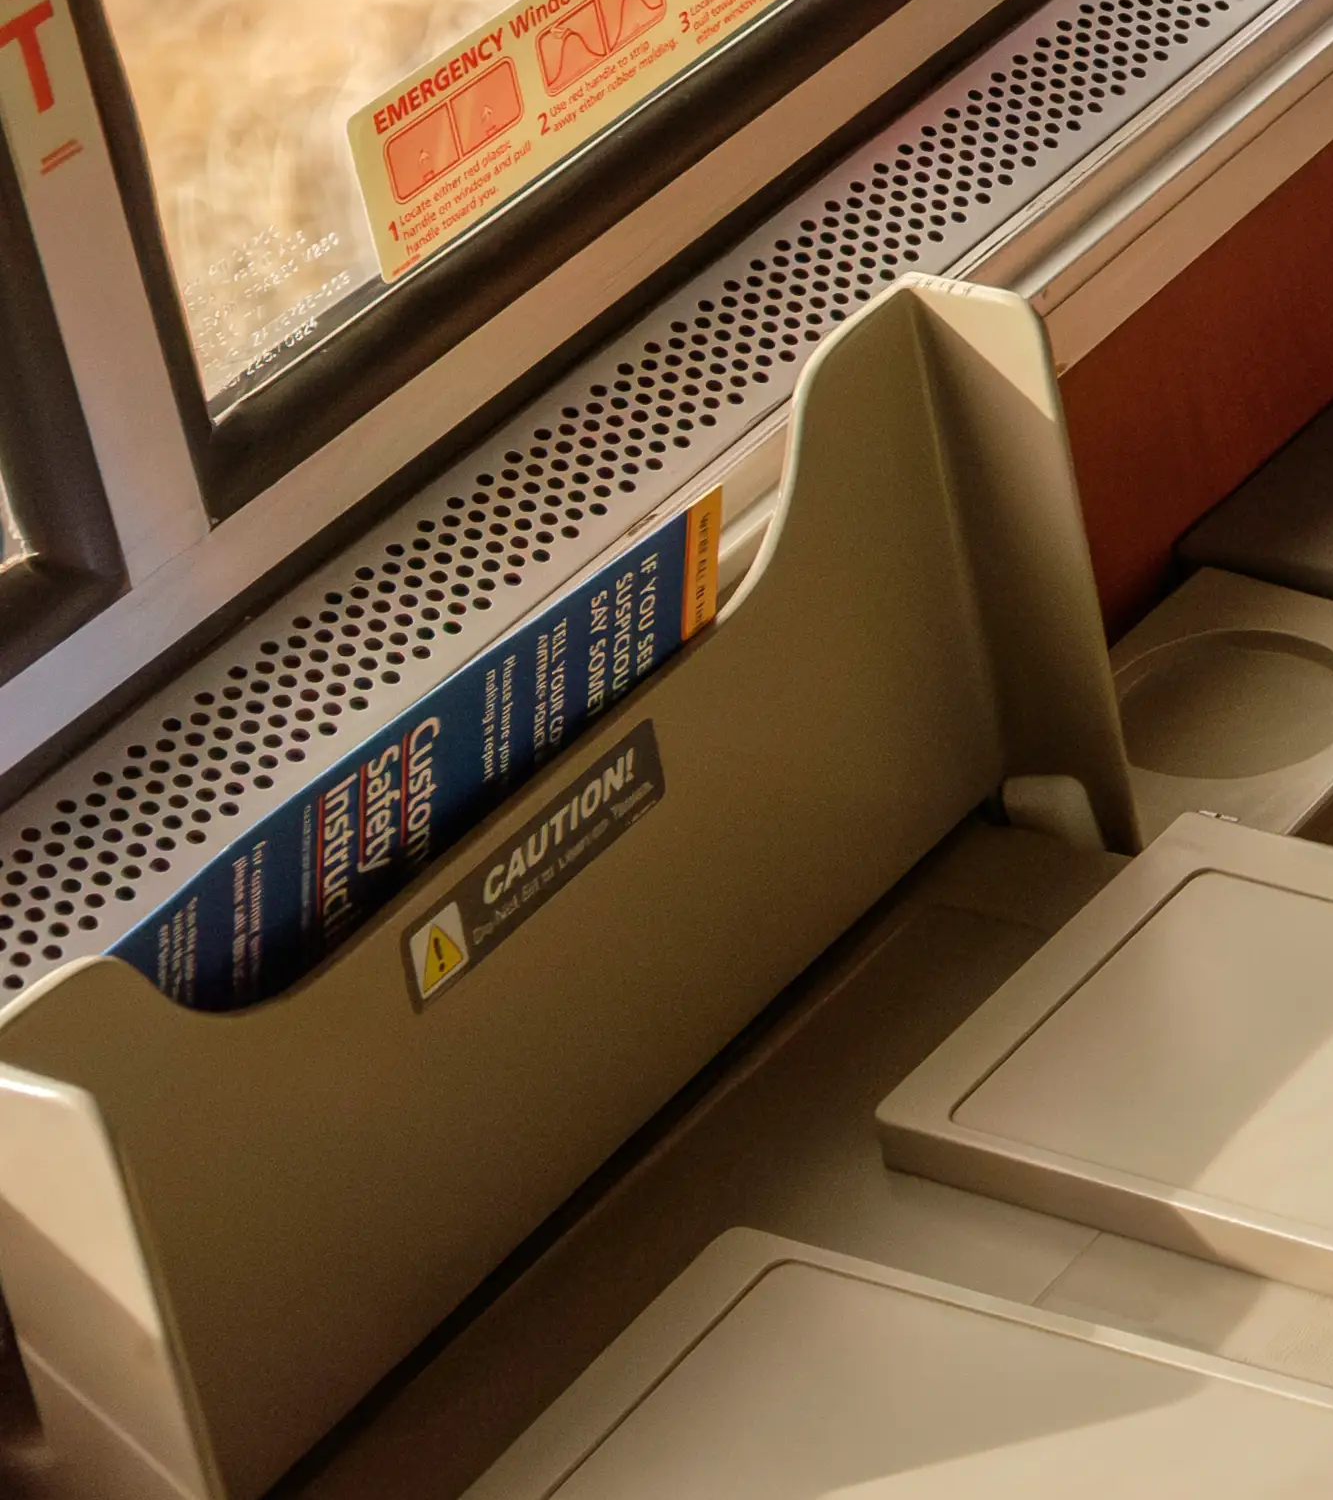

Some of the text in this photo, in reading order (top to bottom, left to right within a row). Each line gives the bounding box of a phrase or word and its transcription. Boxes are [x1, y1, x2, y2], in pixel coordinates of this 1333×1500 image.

[678, 7, 690, 34] 3
[372, 25, 506, 137] EMERGENCY
[548, 37, 650, 119] Use red handle to strip
[537, 109, 550, 136] 2
[552, 108, 577, 136] away
[577, 84, 606, 115] either
[399, 136, 512, 228] Locate either red plastic
[402, 138, 533, 242] handle on window and pull
[386, 218, 400, 246] 1
[405, 221, 440, 258] handle
[441, 195, 477, 231] toward
[589, 589, 609, 640] SAY
[637, 551, 659, 677] IF YOU SEE
[482, 668, 500, 724] making
[501, 654, 518, 703] Please
[547, 617, 569, 749] TELL YOUR CO
[499, 701, 515, 742] have
[479, 733, 496, 785] report
[356, 744, 401, 874] Safety
[482, 746, 636, 905] CAUTION!
